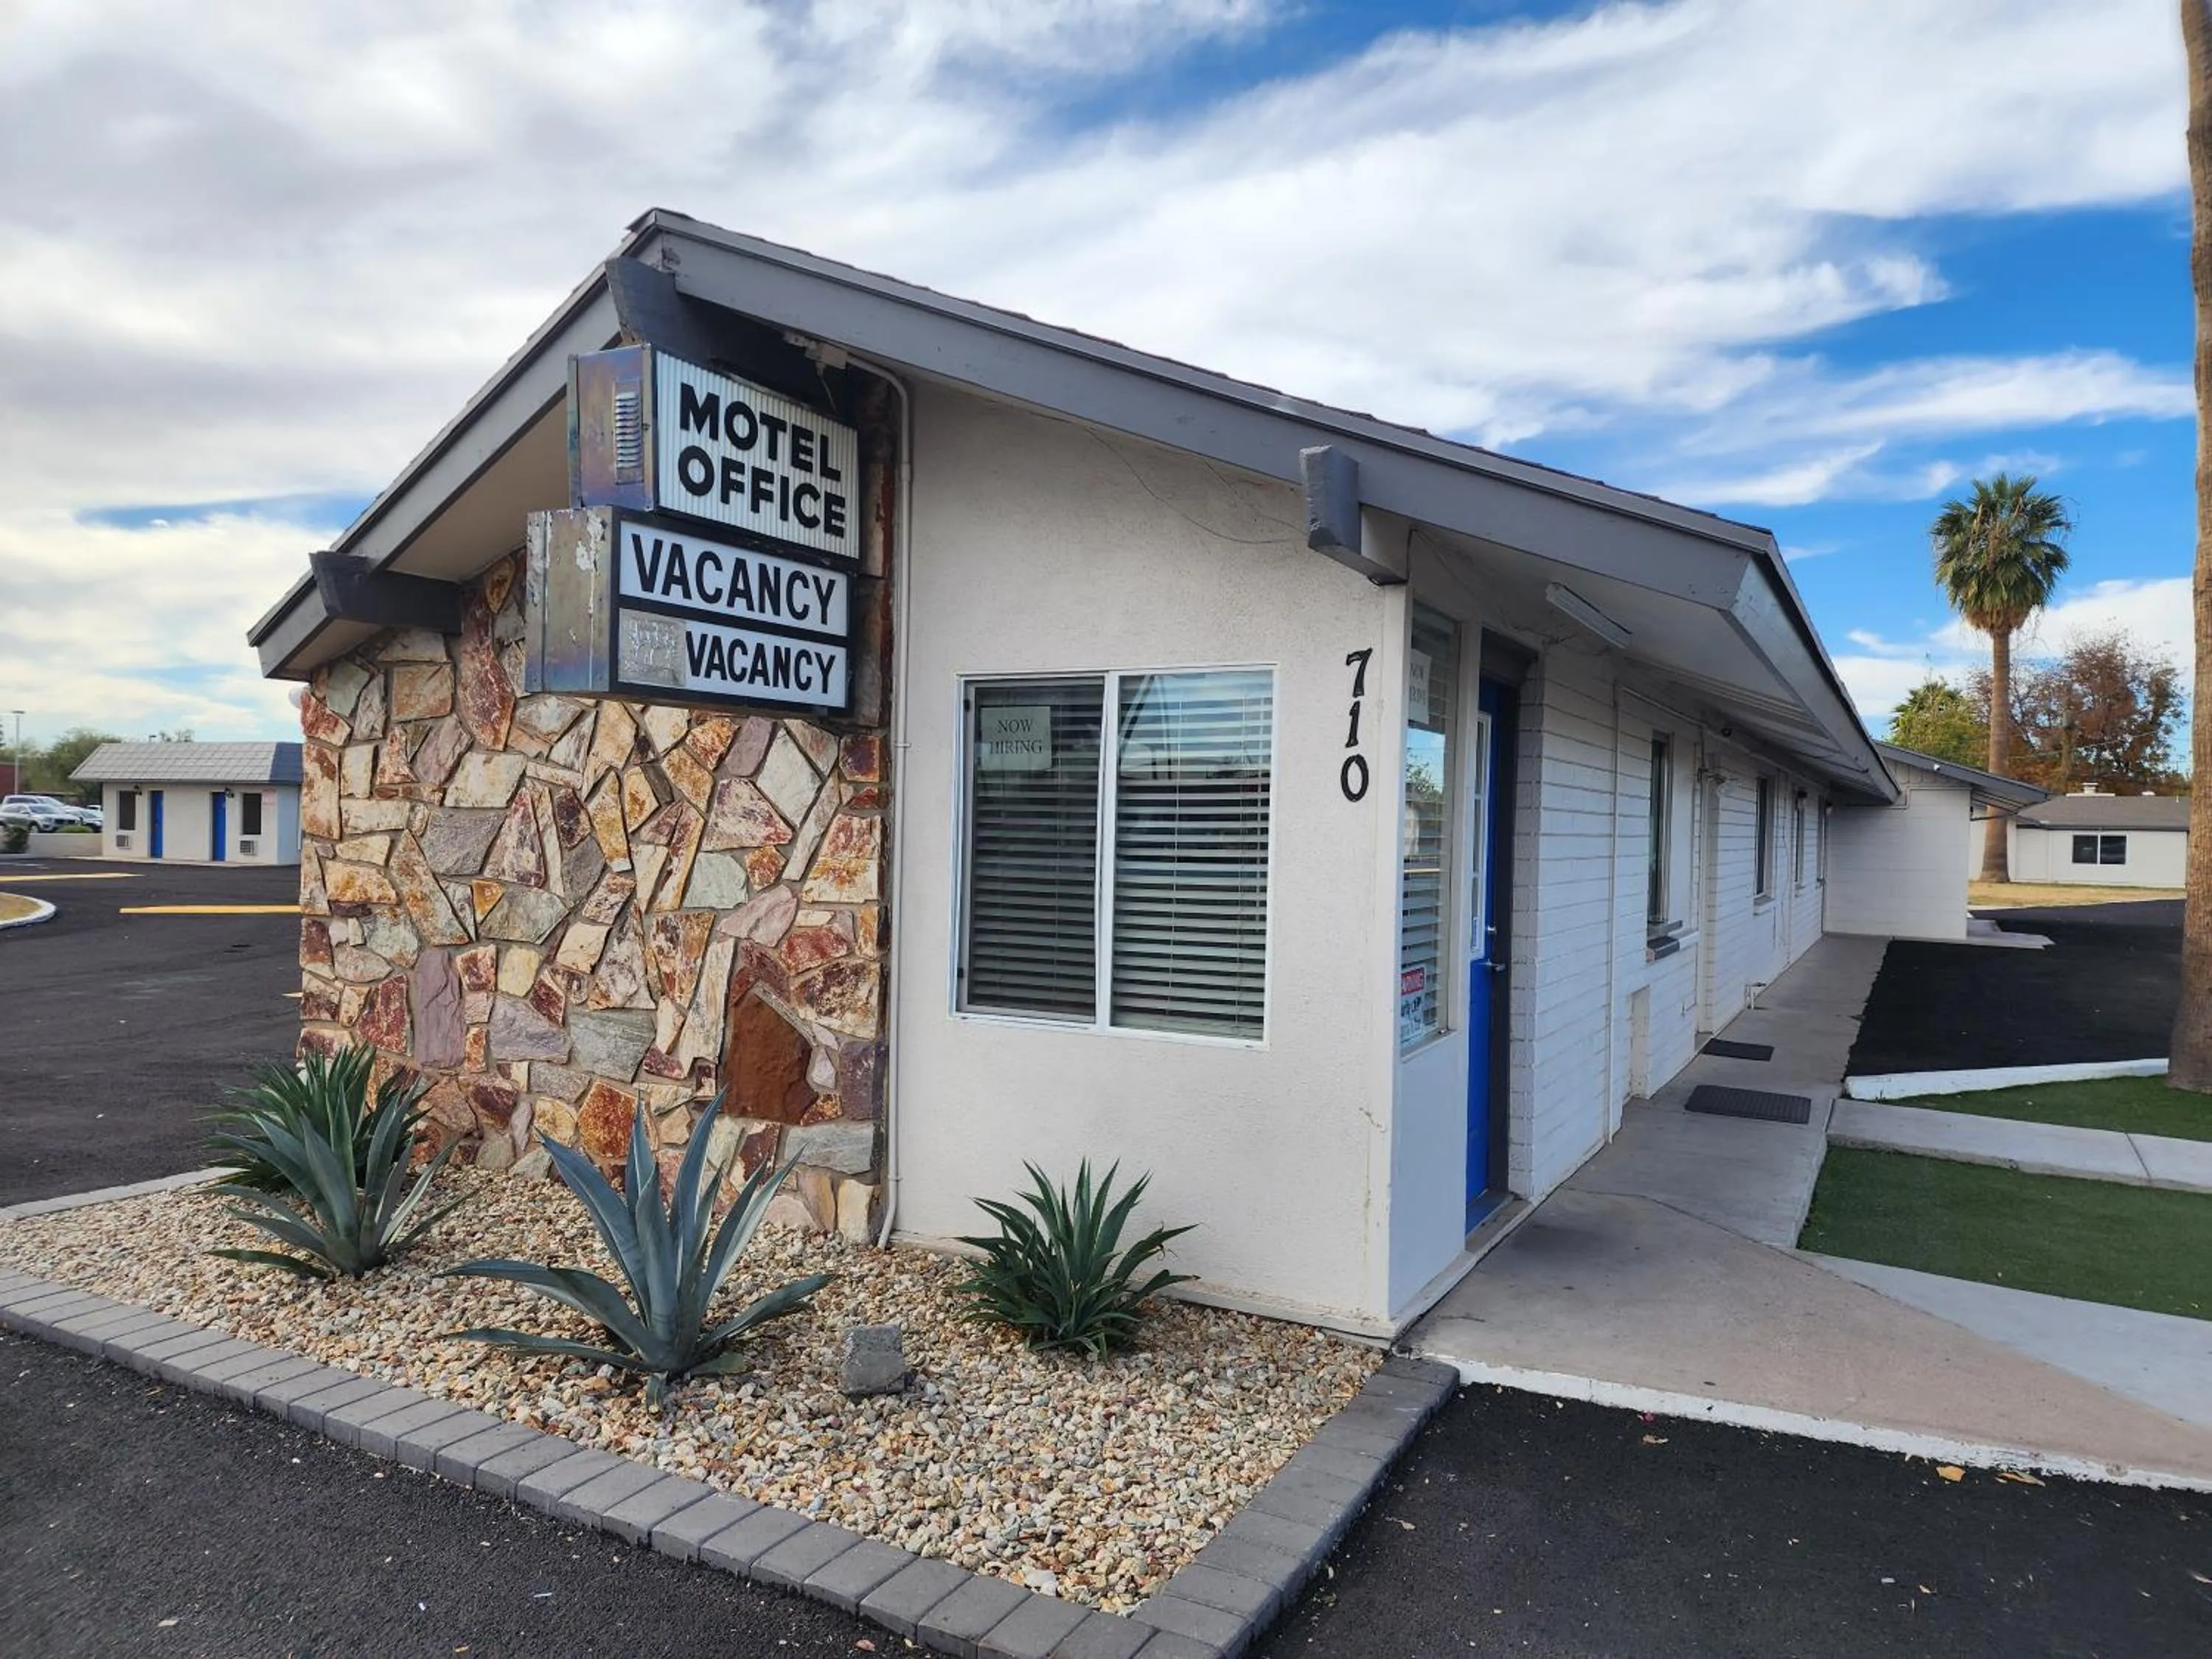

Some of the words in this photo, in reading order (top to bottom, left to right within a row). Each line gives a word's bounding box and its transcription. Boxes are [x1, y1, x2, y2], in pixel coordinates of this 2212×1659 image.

[680, 383, 841, 482] MOTEL
[678, 445, 846, 538] OFFICE
[631, 534, 835, 625] VACANCY
[685, 630, 835, 693] VACANCY
[990, 740, 1042, 754] HIRING
[996, 719, 1033, 734] NOW
[1340, 647, 1373, 802] 710
